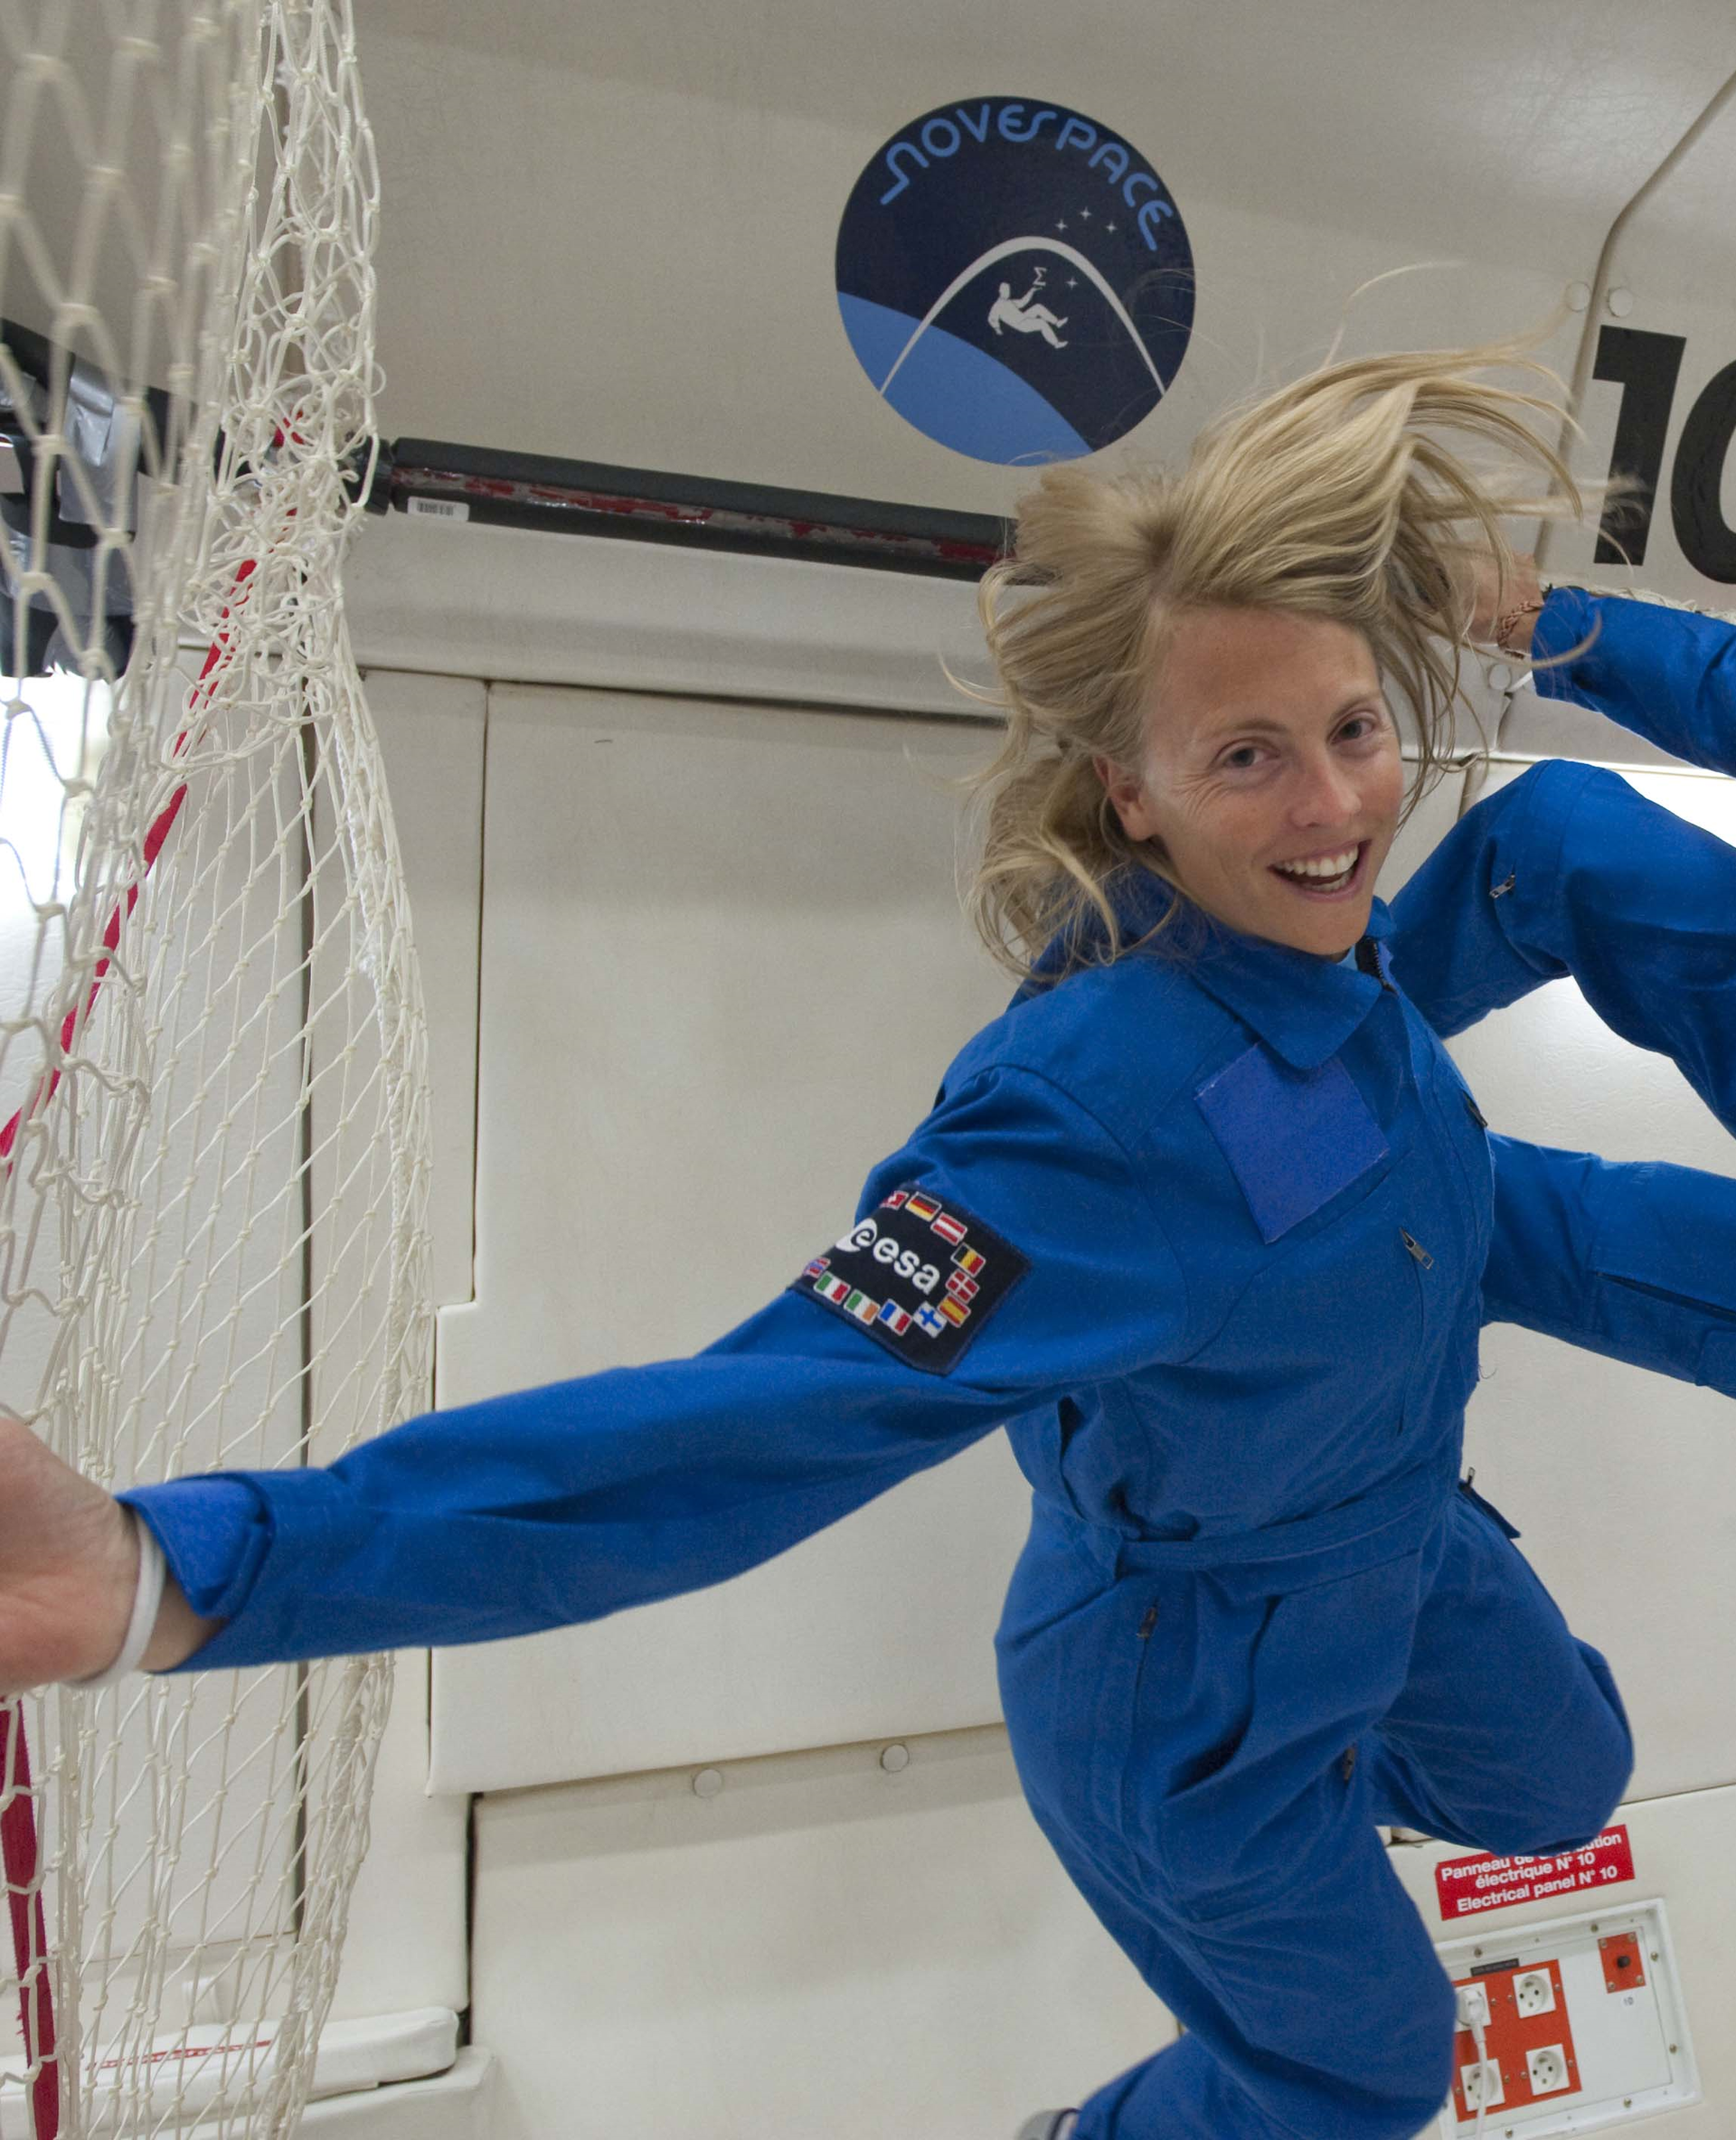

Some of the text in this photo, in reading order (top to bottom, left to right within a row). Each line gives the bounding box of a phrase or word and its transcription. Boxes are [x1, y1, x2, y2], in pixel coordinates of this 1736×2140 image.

[880, 103, 1175, 252] NOVESPACE
[1441, 1856, 1510, 1881] Panneau
[1457, 1885, 1531, 1912] Electrical
[1533, 1874, 1575, 1897] panel
[1599, 1865, 1618, 1881] 10
[1475, 1861, 1553, 1889] électrique
[1577, 1852, 1596, 1867] 10
